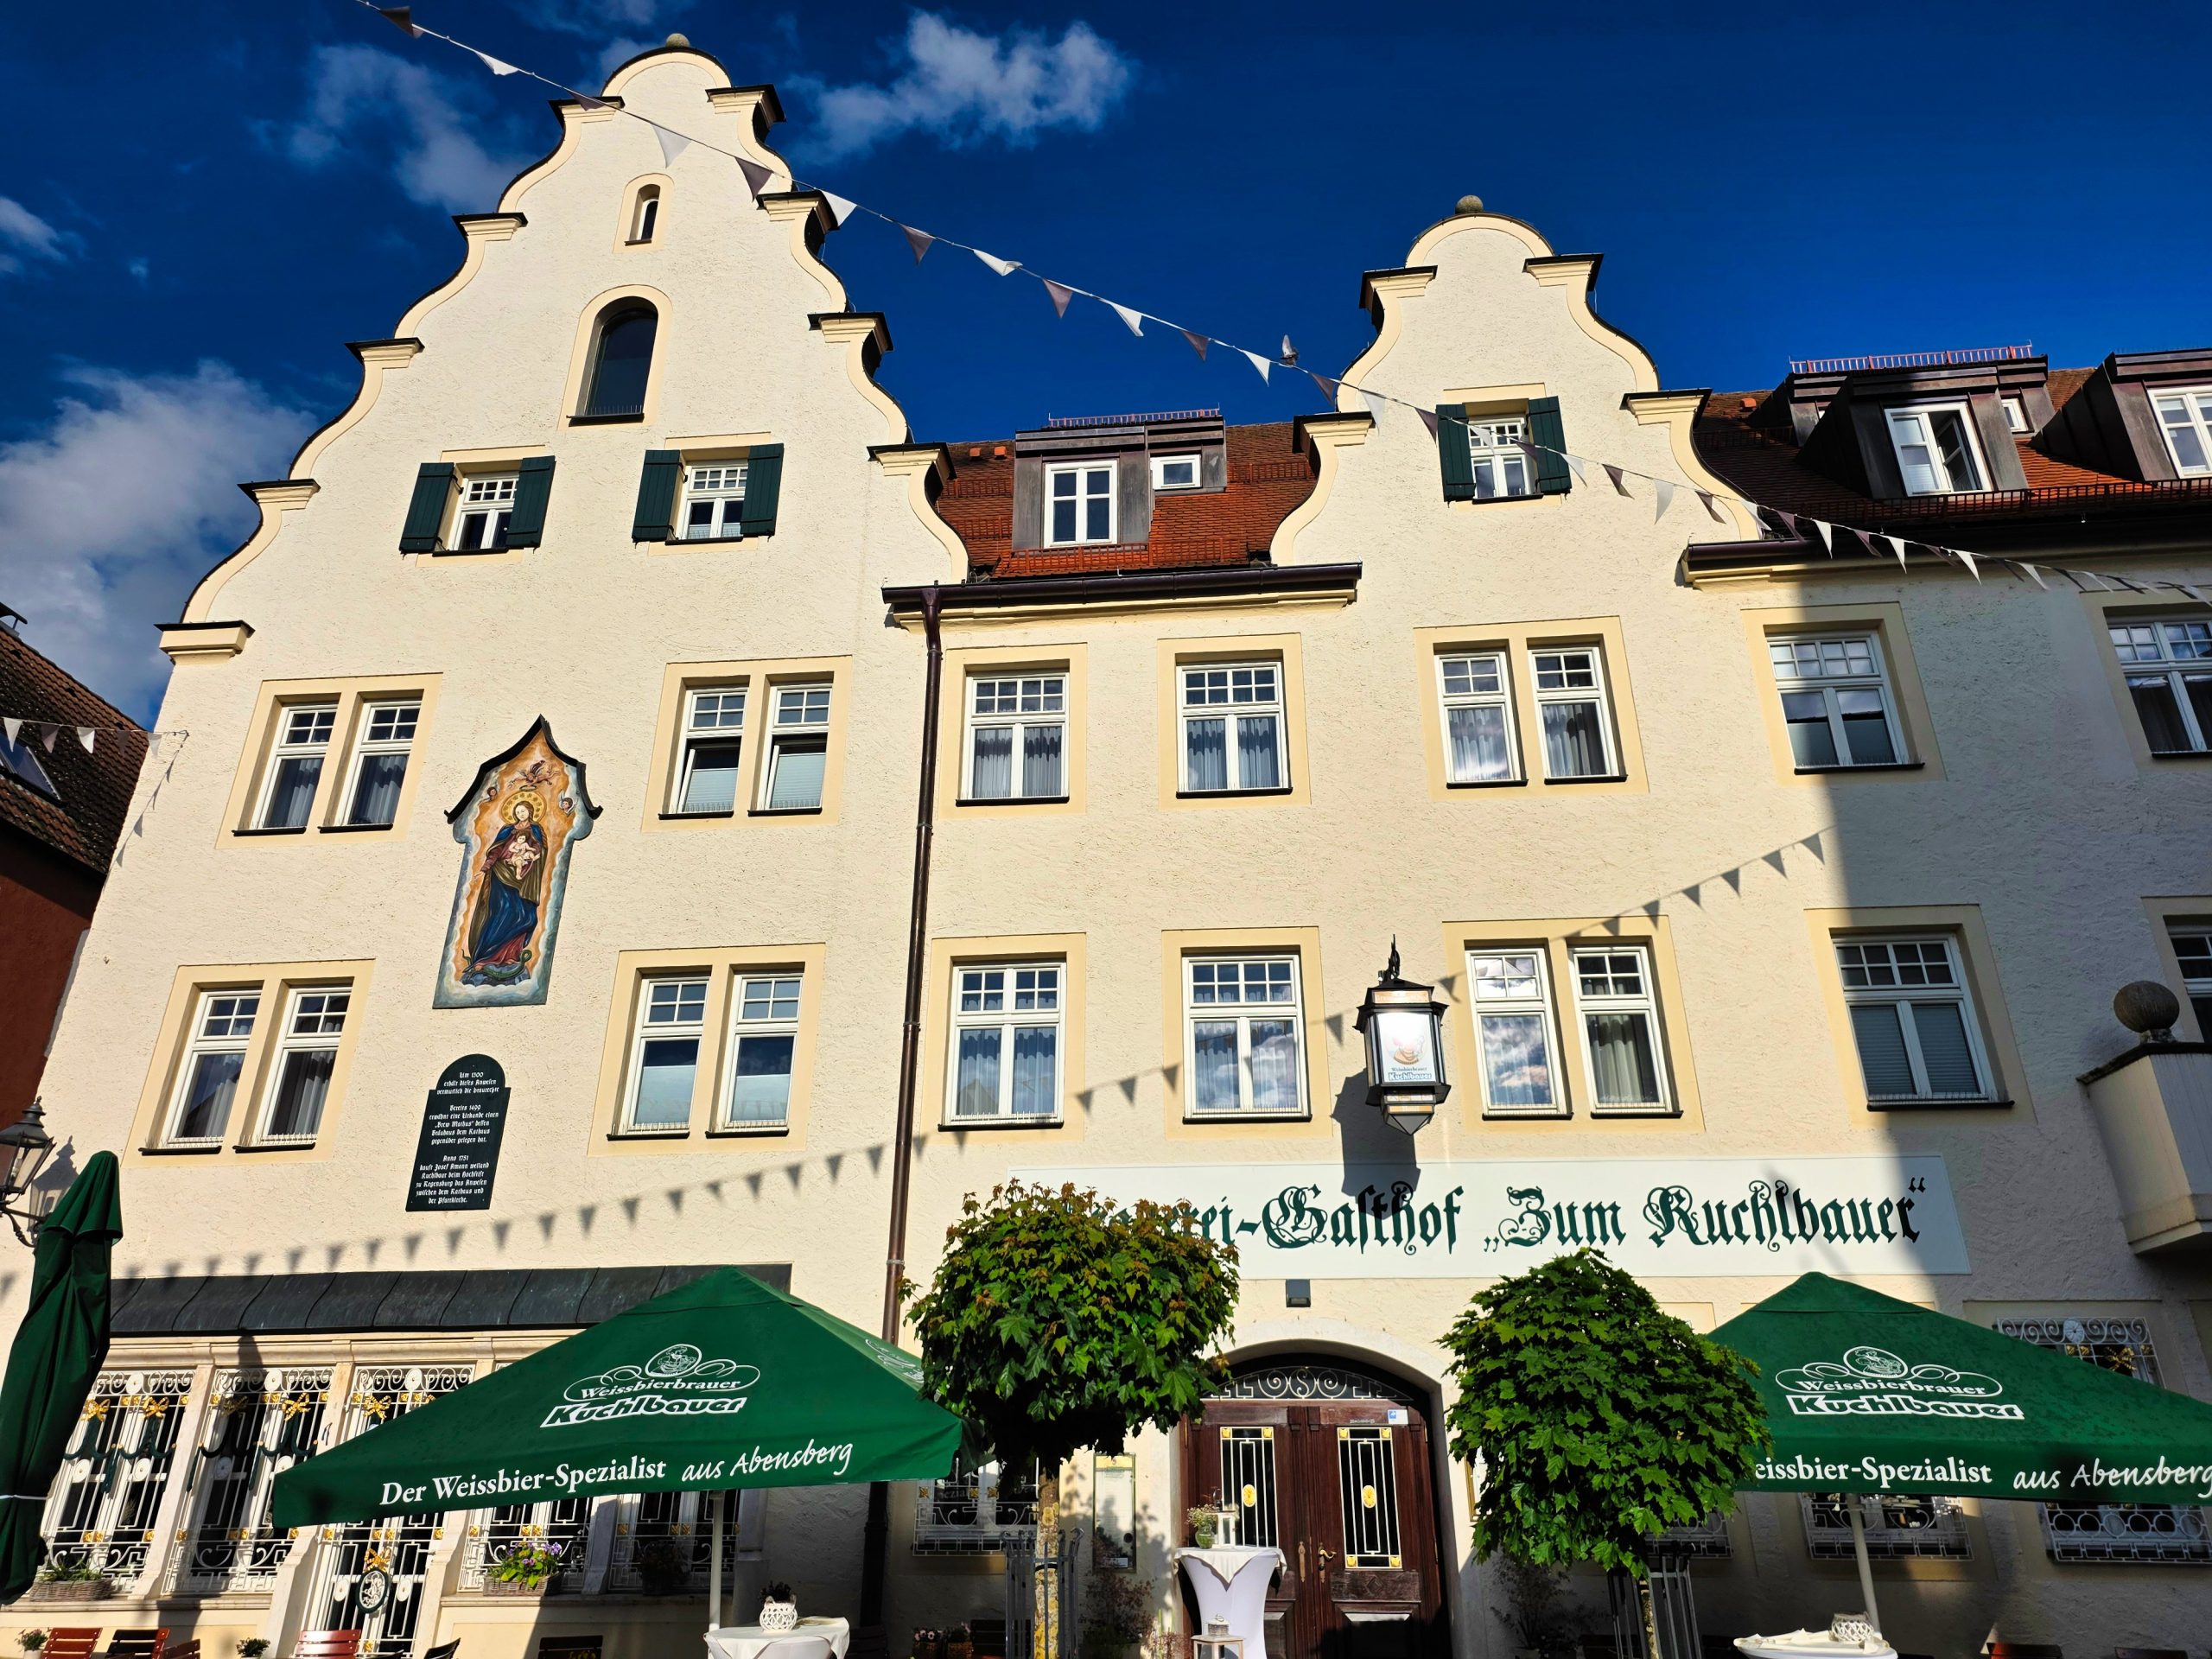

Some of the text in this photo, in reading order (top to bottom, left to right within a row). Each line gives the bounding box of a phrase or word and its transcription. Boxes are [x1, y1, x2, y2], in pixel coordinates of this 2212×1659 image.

[1388, 1071, 1433, 1081] Kuchlbauer
[581, 1377, 741, 1399] Weissbierbrauer
[1795, 1378, 1987, 1395] Weissbierbrauer
[539, 1395, 747, 1428] Kuchlbauer
[1785, 1394, 2025, 1420] Kuchlbauer
[379, 1437, 854, 1505] Der Weissbier-Spezialist aus Abensberg
[1754, 1454, 2212, 1498] eissbier-Spezialist aus Abensberg
